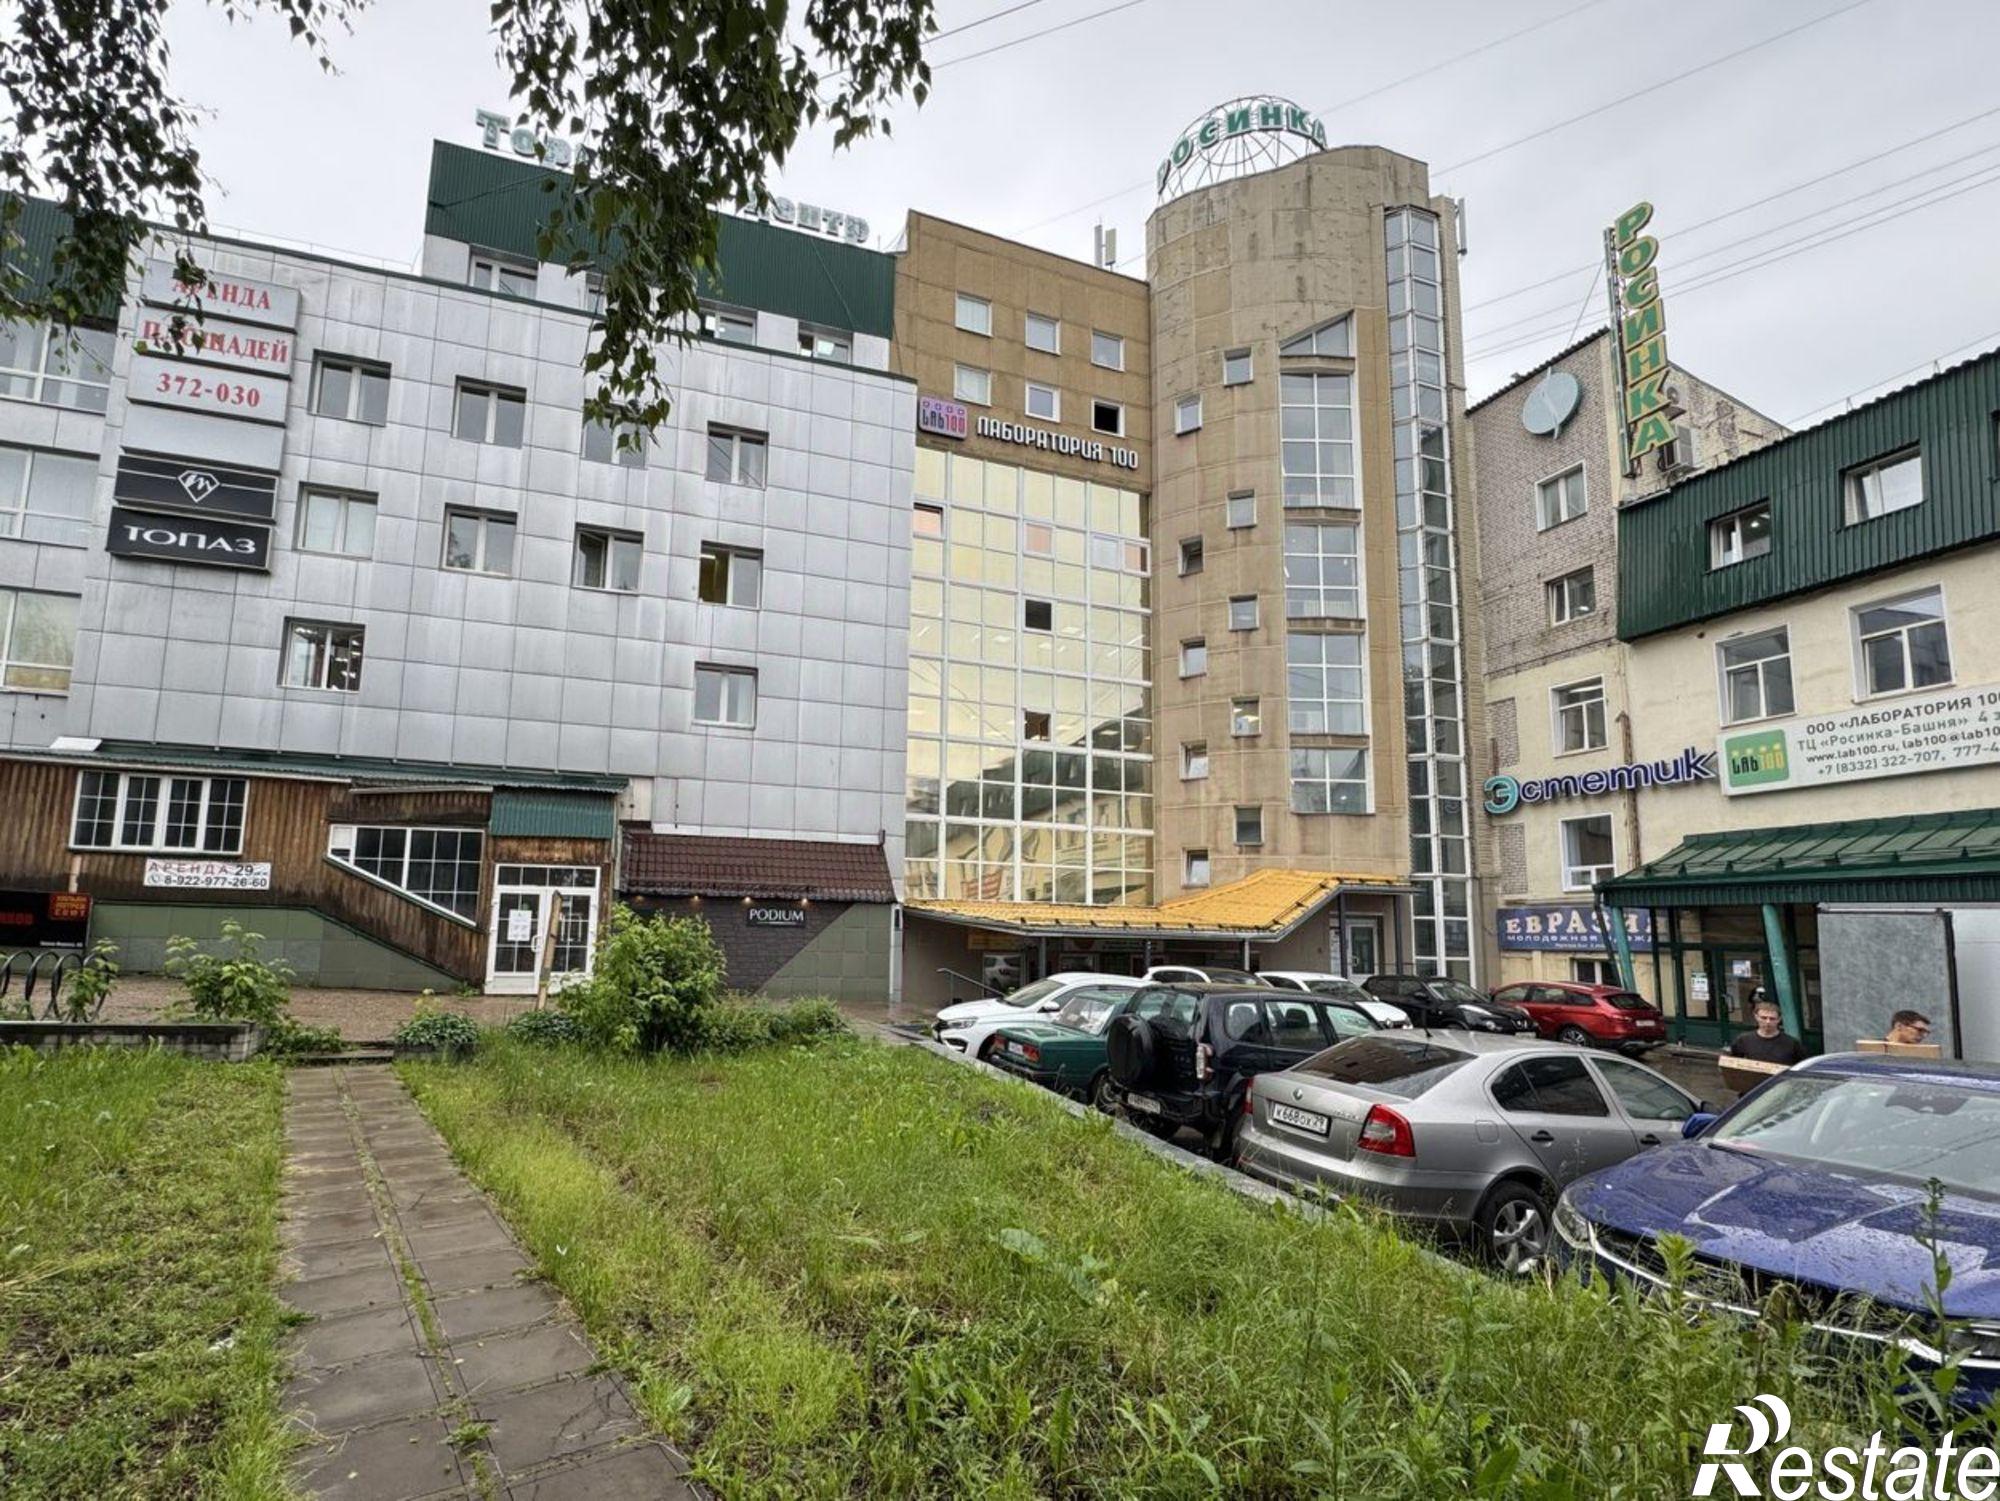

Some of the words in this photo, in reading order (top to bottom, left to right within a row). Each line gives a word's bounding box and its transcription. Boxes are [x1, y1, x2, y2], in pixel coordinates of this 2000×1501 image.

[1613, 201, 1679, 459] РОСИНКА
[156, 372, 260, 408] 372-030
[976, 415, 1103, 461] ЛАБОРАТОРИЯ
[1109, 445, 1139, 470] 100
[123, 524, 257, 554] ТОПАЗ
[1806, 720, 1836, 736] ООО
[1839, 696, 1972, 731] «ЛАБОРАТОРИЯ
[1977, 691, 2000, 707] 10
[1797, 738, 1817, 752] ТЦ
[1817, 764, 1832, 776] +7
[148, 862, 231, 876] АРЕНДА
[749, 908, 804, 921] PODIUM
